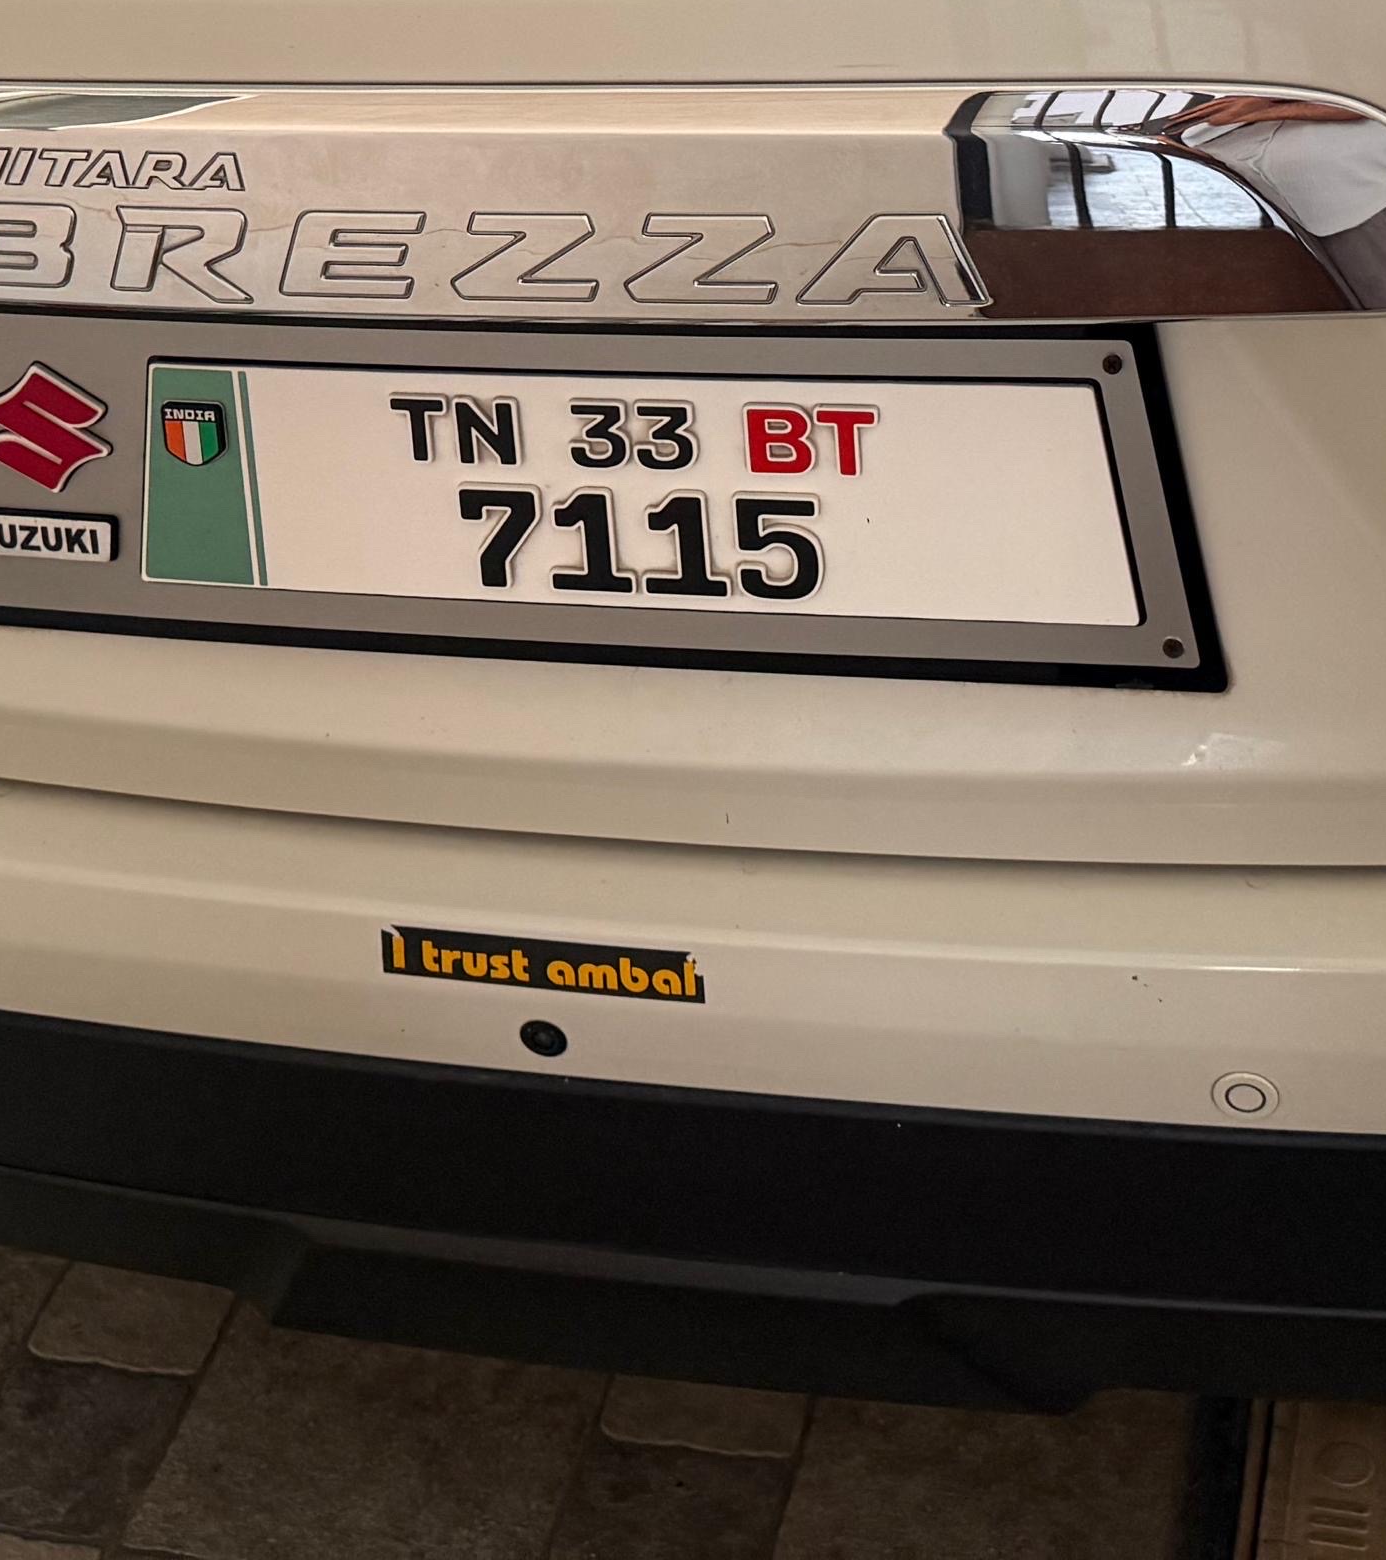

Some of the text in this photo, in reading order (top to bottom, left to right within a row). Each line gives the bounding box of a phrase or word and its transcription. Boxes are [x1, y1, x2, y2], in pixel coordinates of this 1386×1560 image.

[164, 407, 216, 423] INDIA
[389, 394, 881, 477] TN 33 BT
[457, 486, 825, 601] 7115
[421, 940, 530, 982] trust
[546, 957, 697, 997] ambal
